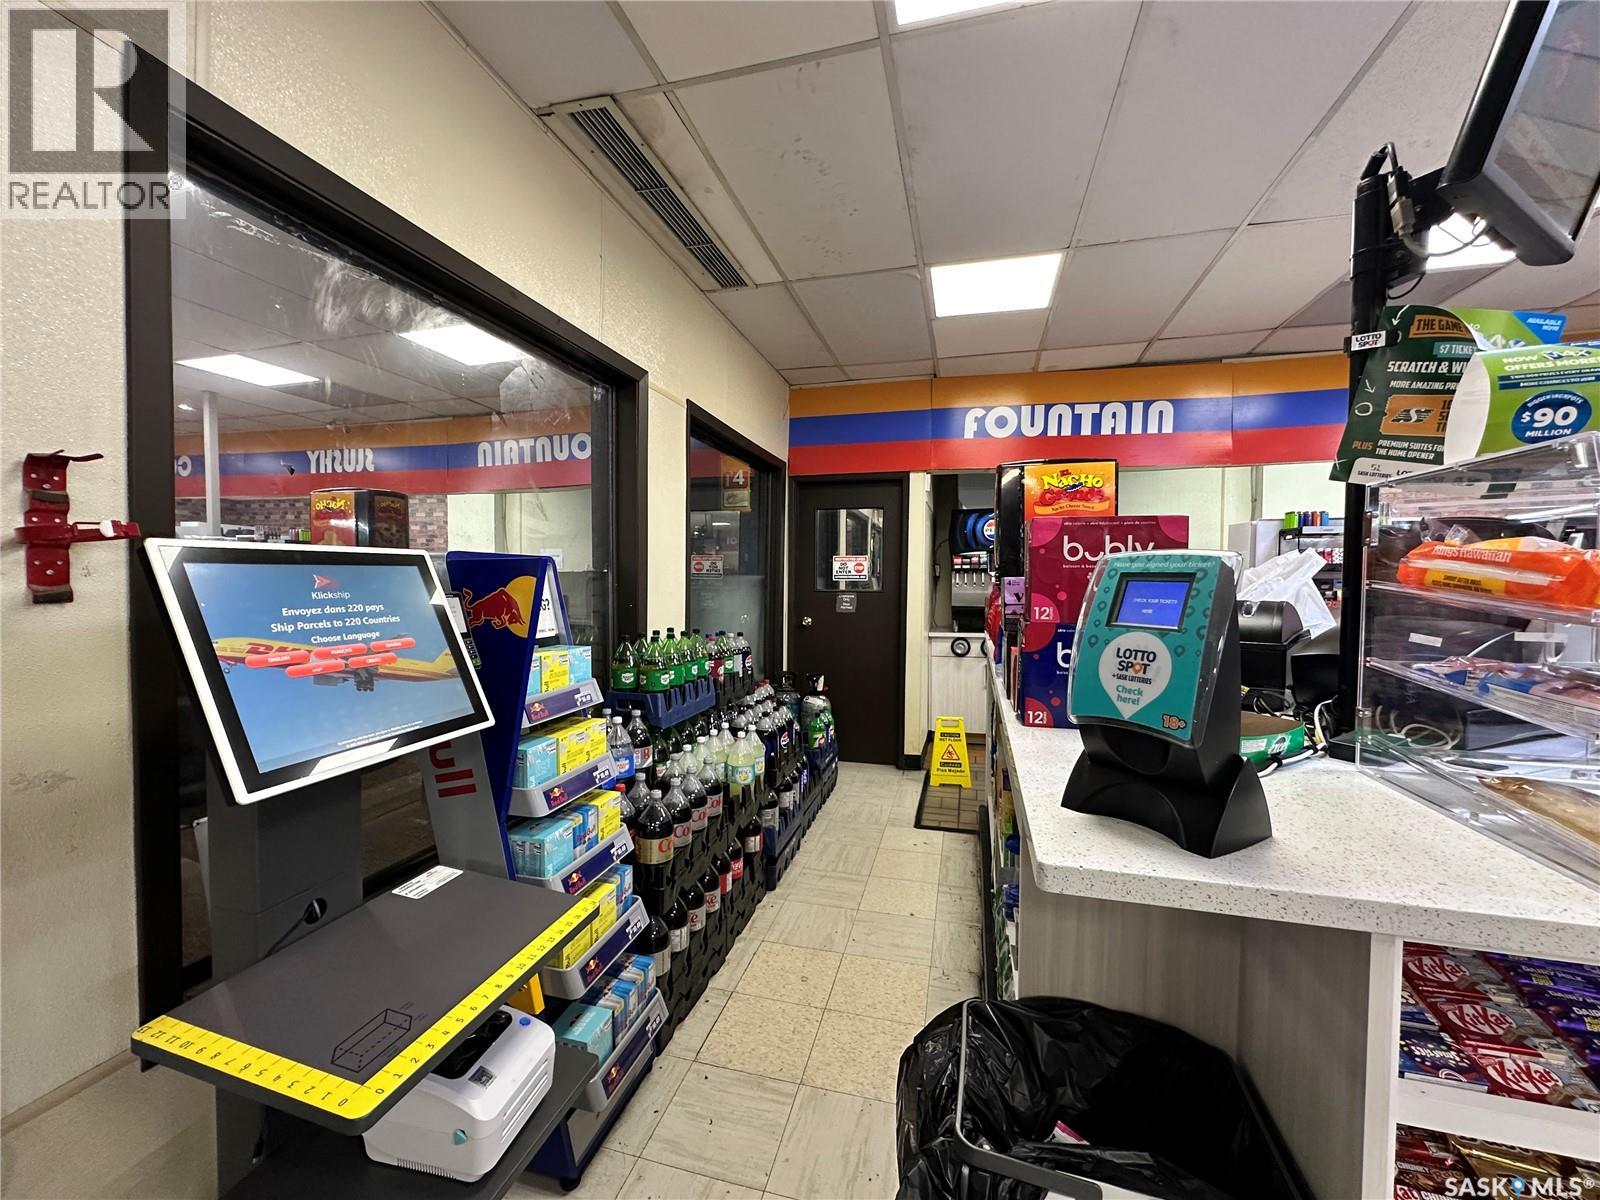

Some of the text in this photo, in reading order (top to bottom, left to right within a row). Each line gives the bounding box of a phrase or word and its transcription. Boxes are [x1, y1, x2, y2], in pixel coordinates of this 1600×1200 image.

[1416, 318, 1437, 332] THE
[1355, 333, 1382, 342] LOTTO
[1358, 339, 1378, 348] SPOT
[1439, 344, 1450, 354] $7
[1387, 360, 1438, 373] SCRATCH
[1439, 362, 1450, 373] &
[1504, 357, 1553, 372] OFFERS
[1389, 380, 1407, 389] MORE
[1408, 380, 1442, 390] AMAZING
[964, 400, 1174, 439] FOUNTAIN
[1520, 405, 1578, 428] $90
[1525, 427, 1572, 438] MILLION
[1352, 440, 1373, 450] PLUS
[1377, 439, 1409, 451] PREMIUM
[1410, 441, 1432, 451] SUITES
[1375, 447, 1434, 460] THE HOME OPENER
[311, 591, 350, 600] Klickship
[282, 603, 384, 618] Envoyez dans 220 pays
[1034, 606, 1050, 620] 12
[270, 616, 401, 633] Ship Parcels to 220 Countries
[311, 630, 380, 644] Choose Language
[1116, 647, 1157, 663] LOTTO
[1117, 660, 1151, 675] SPOT
[1128, 675, 1153, 685] LOTTERIES
[1116, 684, 1144, 697] Check
[1116, 694, 1140, 706] here!
[1027, 711, 1043, 724] 12
[1162, 713, 1187, 730] 18+
[1413, 956, 1467, 982] KitKat
[1454, 1004, 1513, 1034] KitKat
[137, 1026, 348, 1107] 0 1 2 3 4 5 6 7 8 9 10 11 12 13
[393, 1072, 403, 1080] 1
[1495, 1059, 1558, 1093] KitKat
